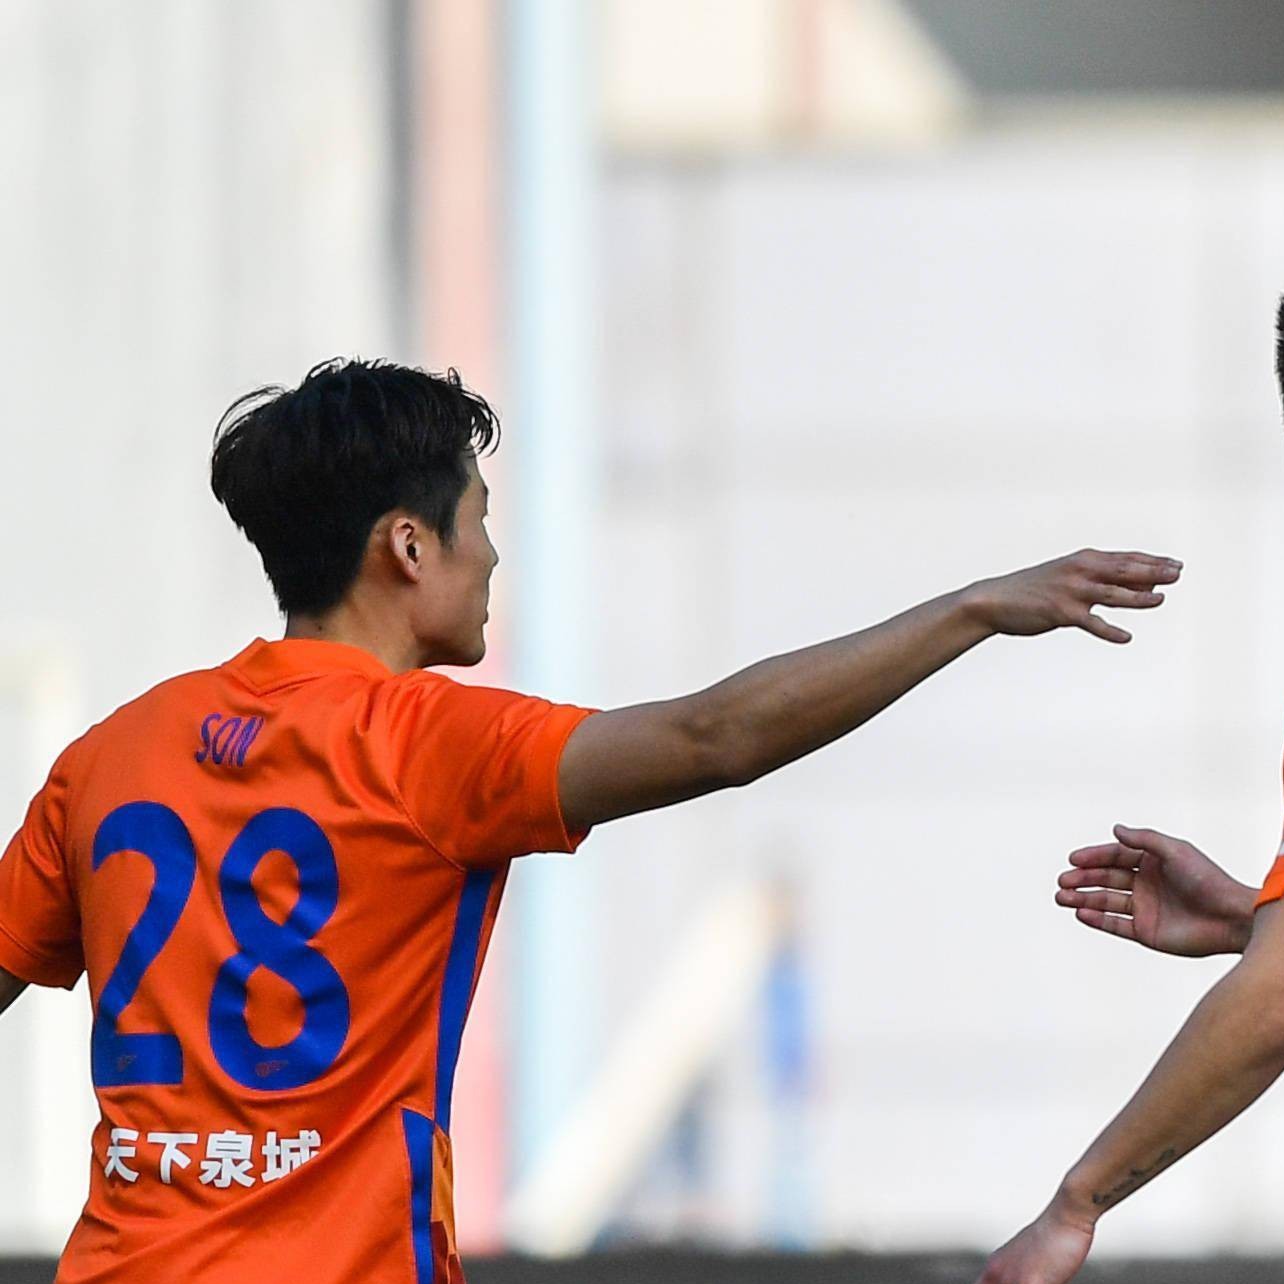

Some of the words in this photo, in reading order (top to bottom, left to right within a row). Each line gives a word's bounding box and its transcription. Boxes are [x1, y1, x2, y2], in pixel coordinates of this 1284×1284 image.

[194, 712, 264, 768] SON
[92, 801, 350, 1092] 28
[104, 1128, 323, 1188] 天下泉城
